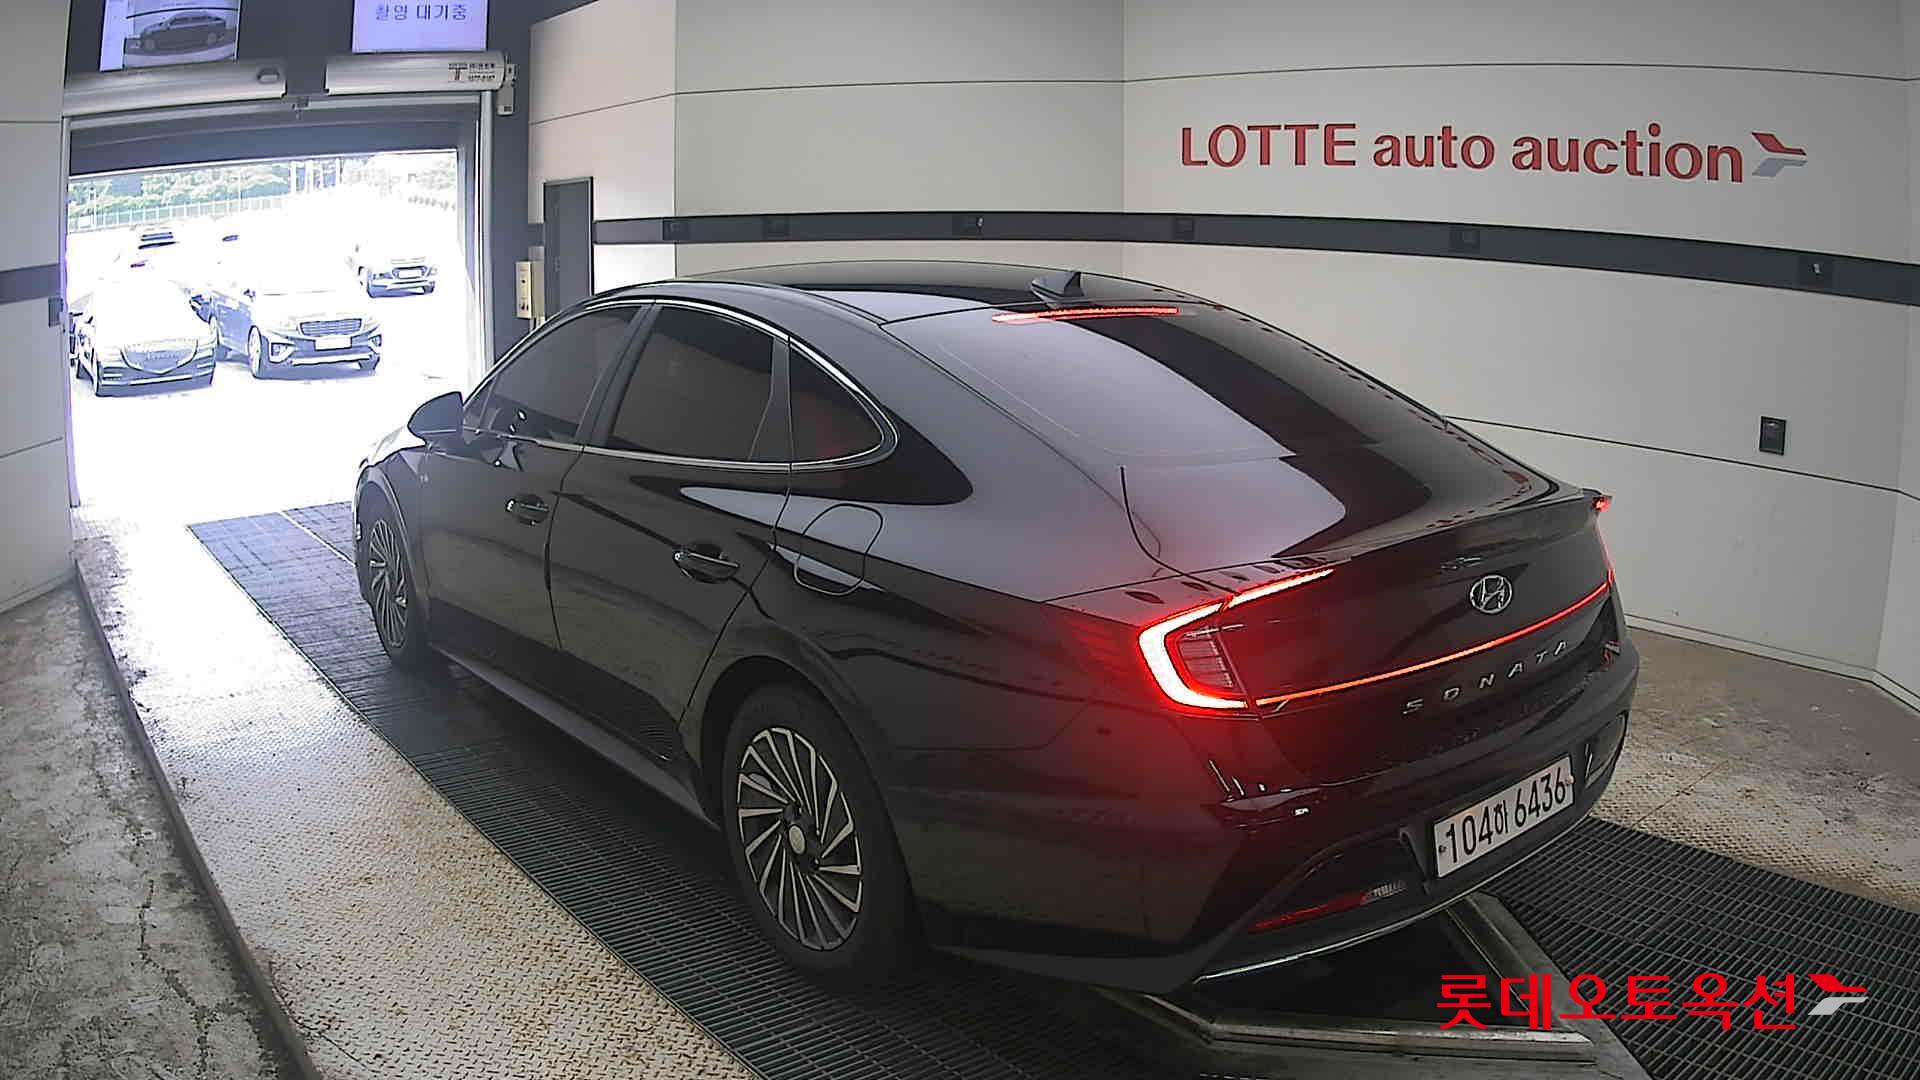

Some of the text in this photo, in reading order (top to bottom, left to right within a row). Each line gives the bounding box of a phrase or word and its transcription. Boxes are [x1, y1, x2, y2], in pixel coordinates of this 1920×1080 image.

[416, 4, 467, 21] 대기중
[1181, 123, 1744, 183] LOTTE auto auction
[1402, 640, 1568, 715] SONATA
[1514, 766, 1566, 828] 6436
